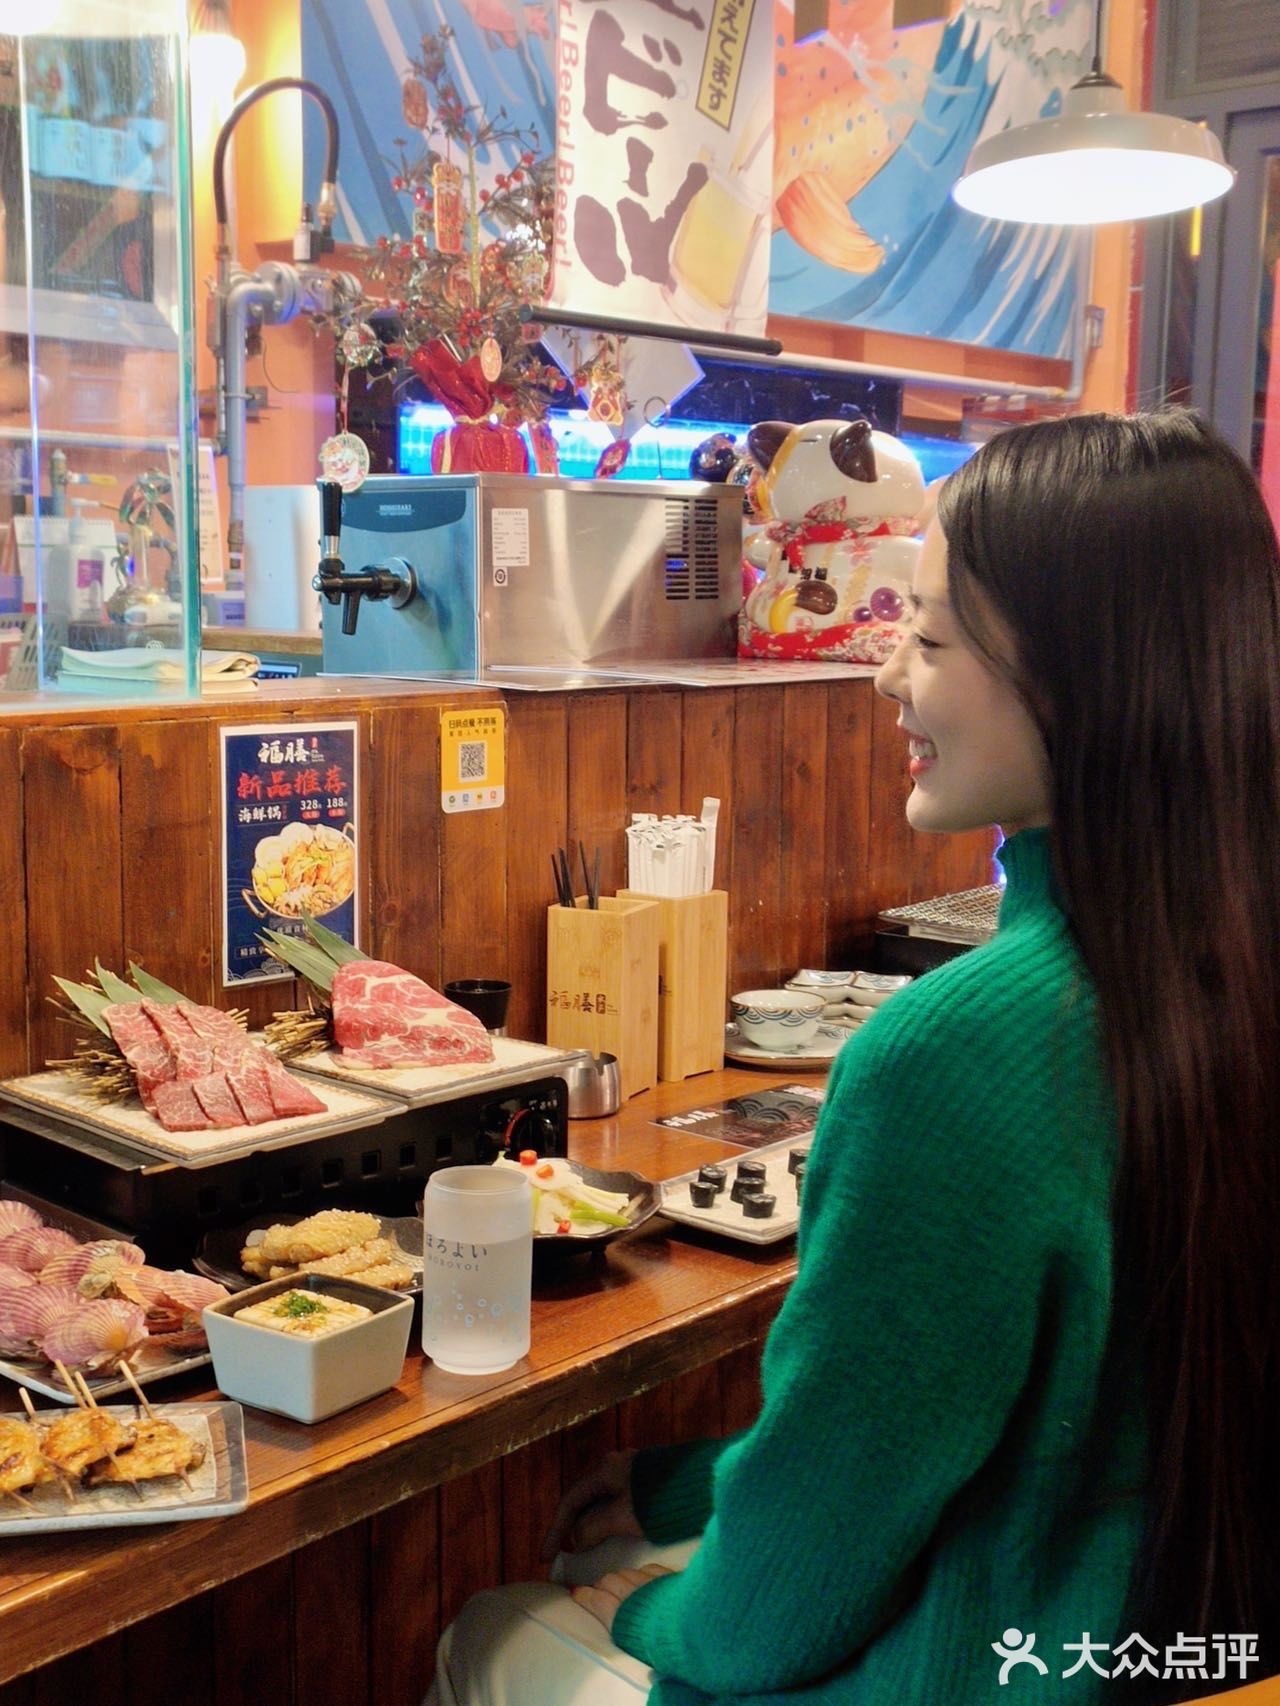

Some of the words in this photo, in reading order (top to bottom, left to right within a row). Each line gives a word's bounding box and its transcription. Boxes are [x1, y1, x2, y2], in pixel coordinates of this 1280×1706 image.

[708, 0, 744, 111] えてます
[573, 0, 709, 290] ビール
[236, 764, 347, 800] 新品推荐
